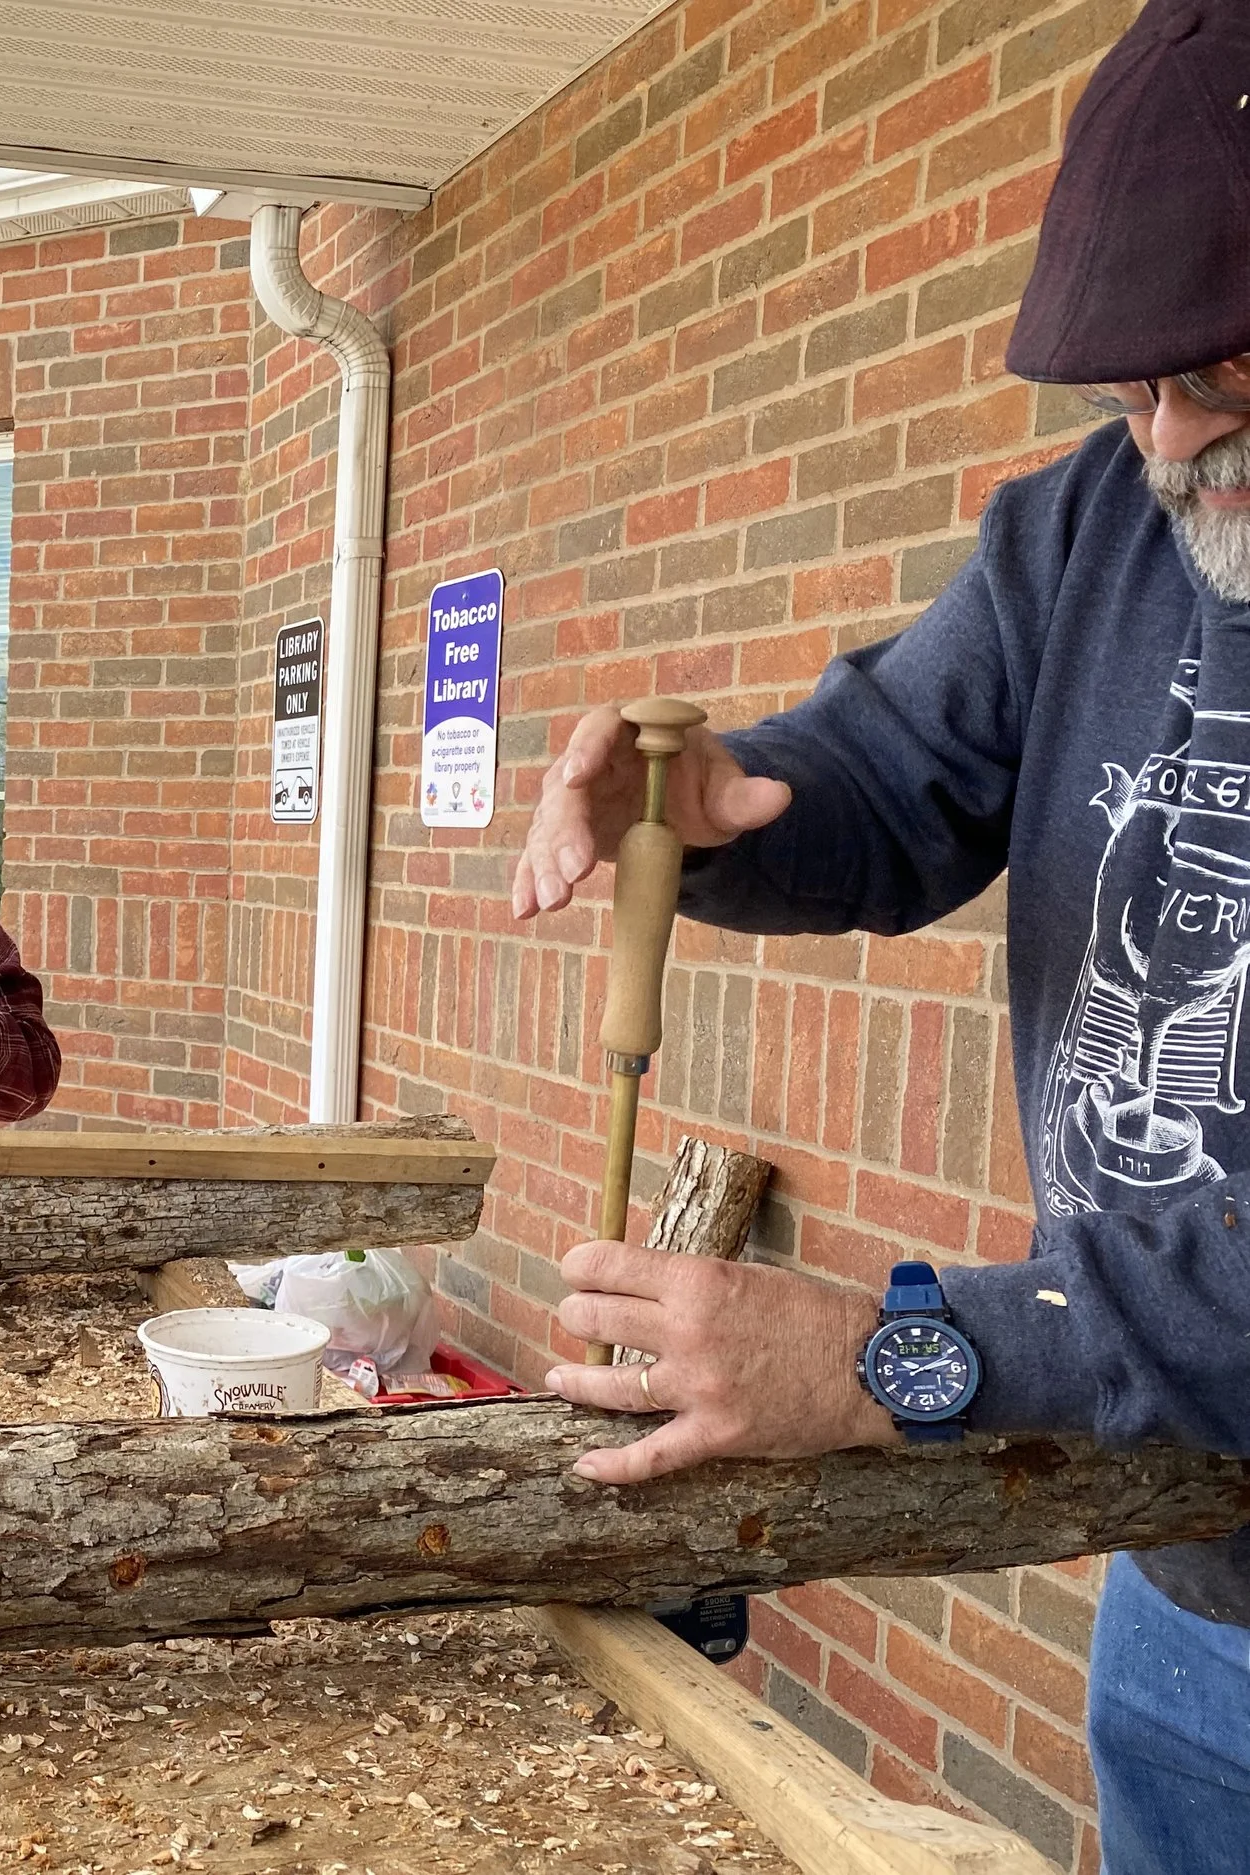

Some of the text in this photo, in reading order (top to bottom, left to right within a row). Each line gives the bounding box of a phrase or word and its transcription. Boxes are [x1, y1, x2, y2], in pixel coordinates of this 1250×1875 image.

[432, 602, 497, 633] Tobacco
[279, 629, 319, 658] LIBRARY
[445, 641, 480, 666] Free
[278, 660, 318, 687] PARKING
[433, 678, 488, 703] Library
[286, 691, 308, 714] ONLY
[437, 728, 480, 741] No tobacco or
[431, 745, 485, 759] e-cigarette use on
[434, 761, 480, 774] library property
[883, 1364, 894, 1376] 3
[950, 1361, 962, 1373] 9
[213, 1383, 284, 1411] SNOWVILLE
[231, 1401, 276, 1411] CREAMERY
[919, 1394, 935, 1406] 12
